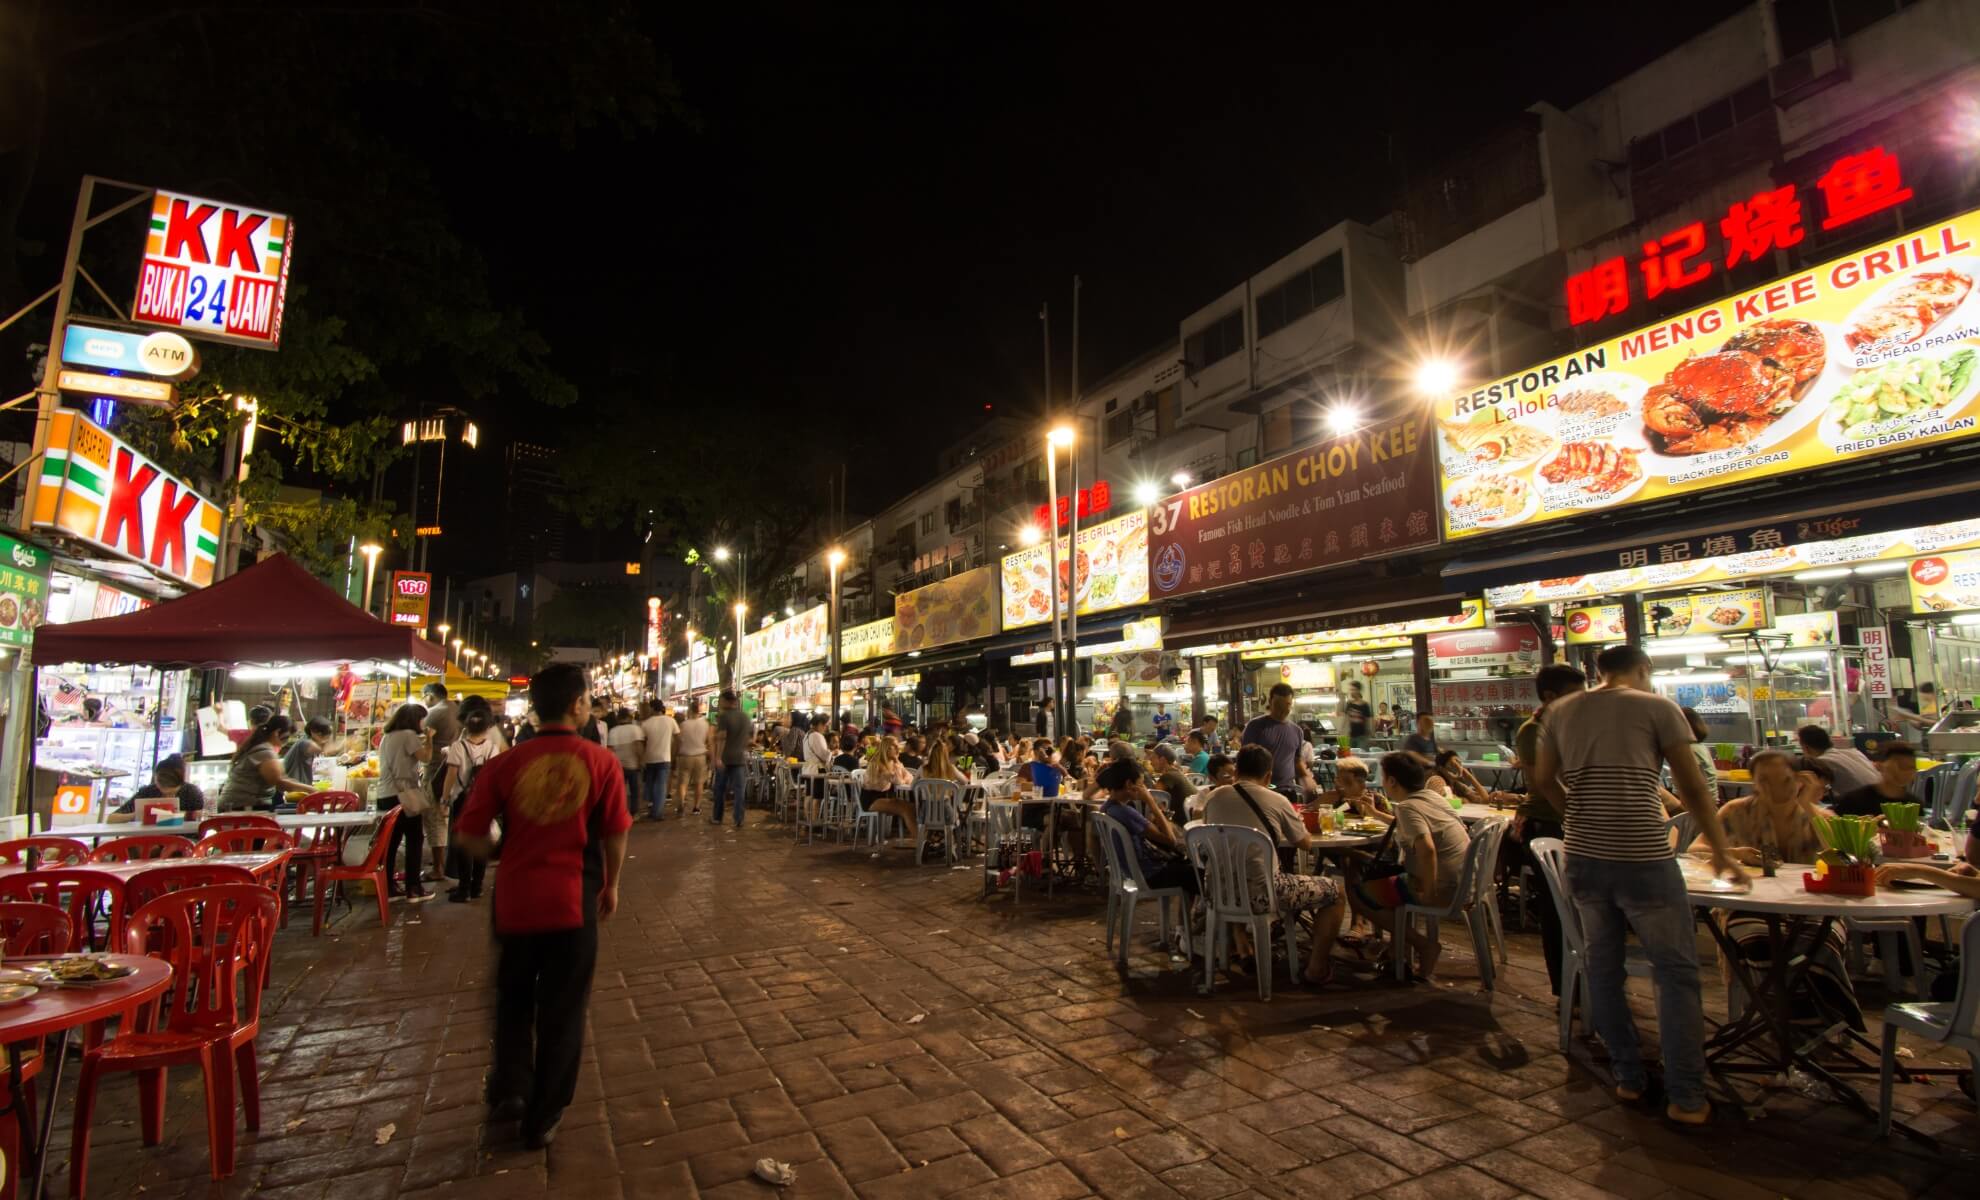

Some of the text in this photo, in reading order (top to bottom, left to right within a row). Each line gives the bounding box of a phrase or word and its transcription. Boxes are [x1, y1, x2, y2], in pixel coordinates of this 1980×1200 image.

[163, 198, 269, 273] KK
[1566, 145, 1913, 327] 明记烧鱼
[139, 264, 185, 320] BUKA
[186, 274, 226, 325] 24
[228, 280, 274, 334] JAM
[1455, 227, 1971, 416] RESTORAN MENG KEE GRILL
[148, 347, 185, 361] ATM
[1855, 327, 1980, 368] BIG HEAD PRAWN
[1494, 393, 1560, 424] Lalola
[1559, 422, 1587, 437] SATAY
[1588, 411, 1633, 429] CHICKEN
[1593, 423, 1618, 438] BEEF
[1835, 417, 1975, 455] FRIED BABY KAILAN
[1152, 420, 1417, 535] 37 RESTORAN CHOY KEE
[1668, 450, 1790, 485] BLACK PEPPER CRAB
[101, 447, 200, 577] KK
[1198, 471, 1406, 543] Famous Fish Head Noodle & Tom Yam Seafood
[1543, 492, 1612, 513] CHICKEN WING
[1005, 549, 1043, 567] RESTORAN
[1090, 523, 1118, 541] GRILL
[1120, 513, 1143, 531] FISH
[1449, 520, 1478, 532] PRAWN
[1813, 518, 1861, 537] Tiger
[1618, 529, 1785, 568] 明記燒魚
[398, 579, 428, 595] 168
[1677, 682, 1737, 698] PENANG
